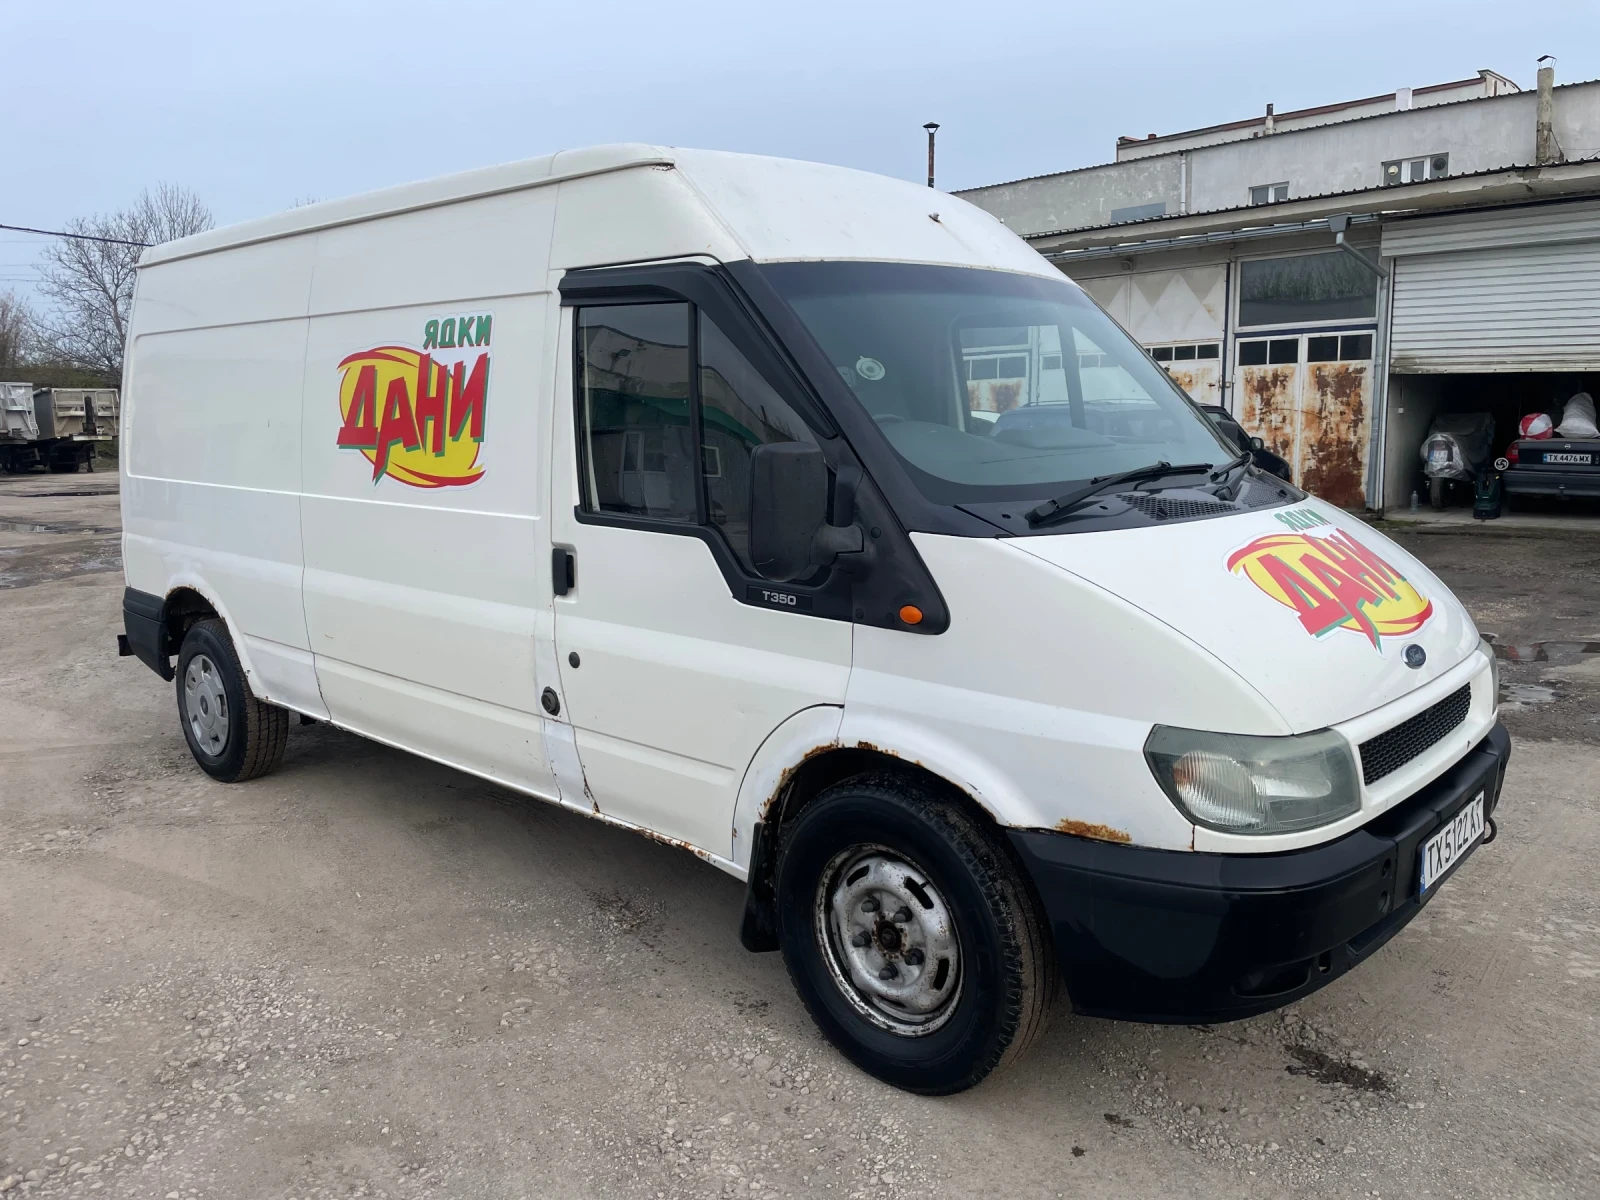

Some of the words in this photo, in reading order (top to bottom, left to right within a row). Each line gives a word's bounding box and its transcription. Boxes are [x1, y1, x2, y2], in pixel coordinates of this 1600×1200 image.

[423, 315, 492, 350] ЯДКИ
[336, 352, 490, 486] ДАНИ
[762, 591, 797, 606] T350
[1254, 527, 1407, 654] ДАНИ
[1427, 836, 1443, 879] TX
[1445, 811, 1469, 864] 5122
[1470, 797, 1482, 838] AT
